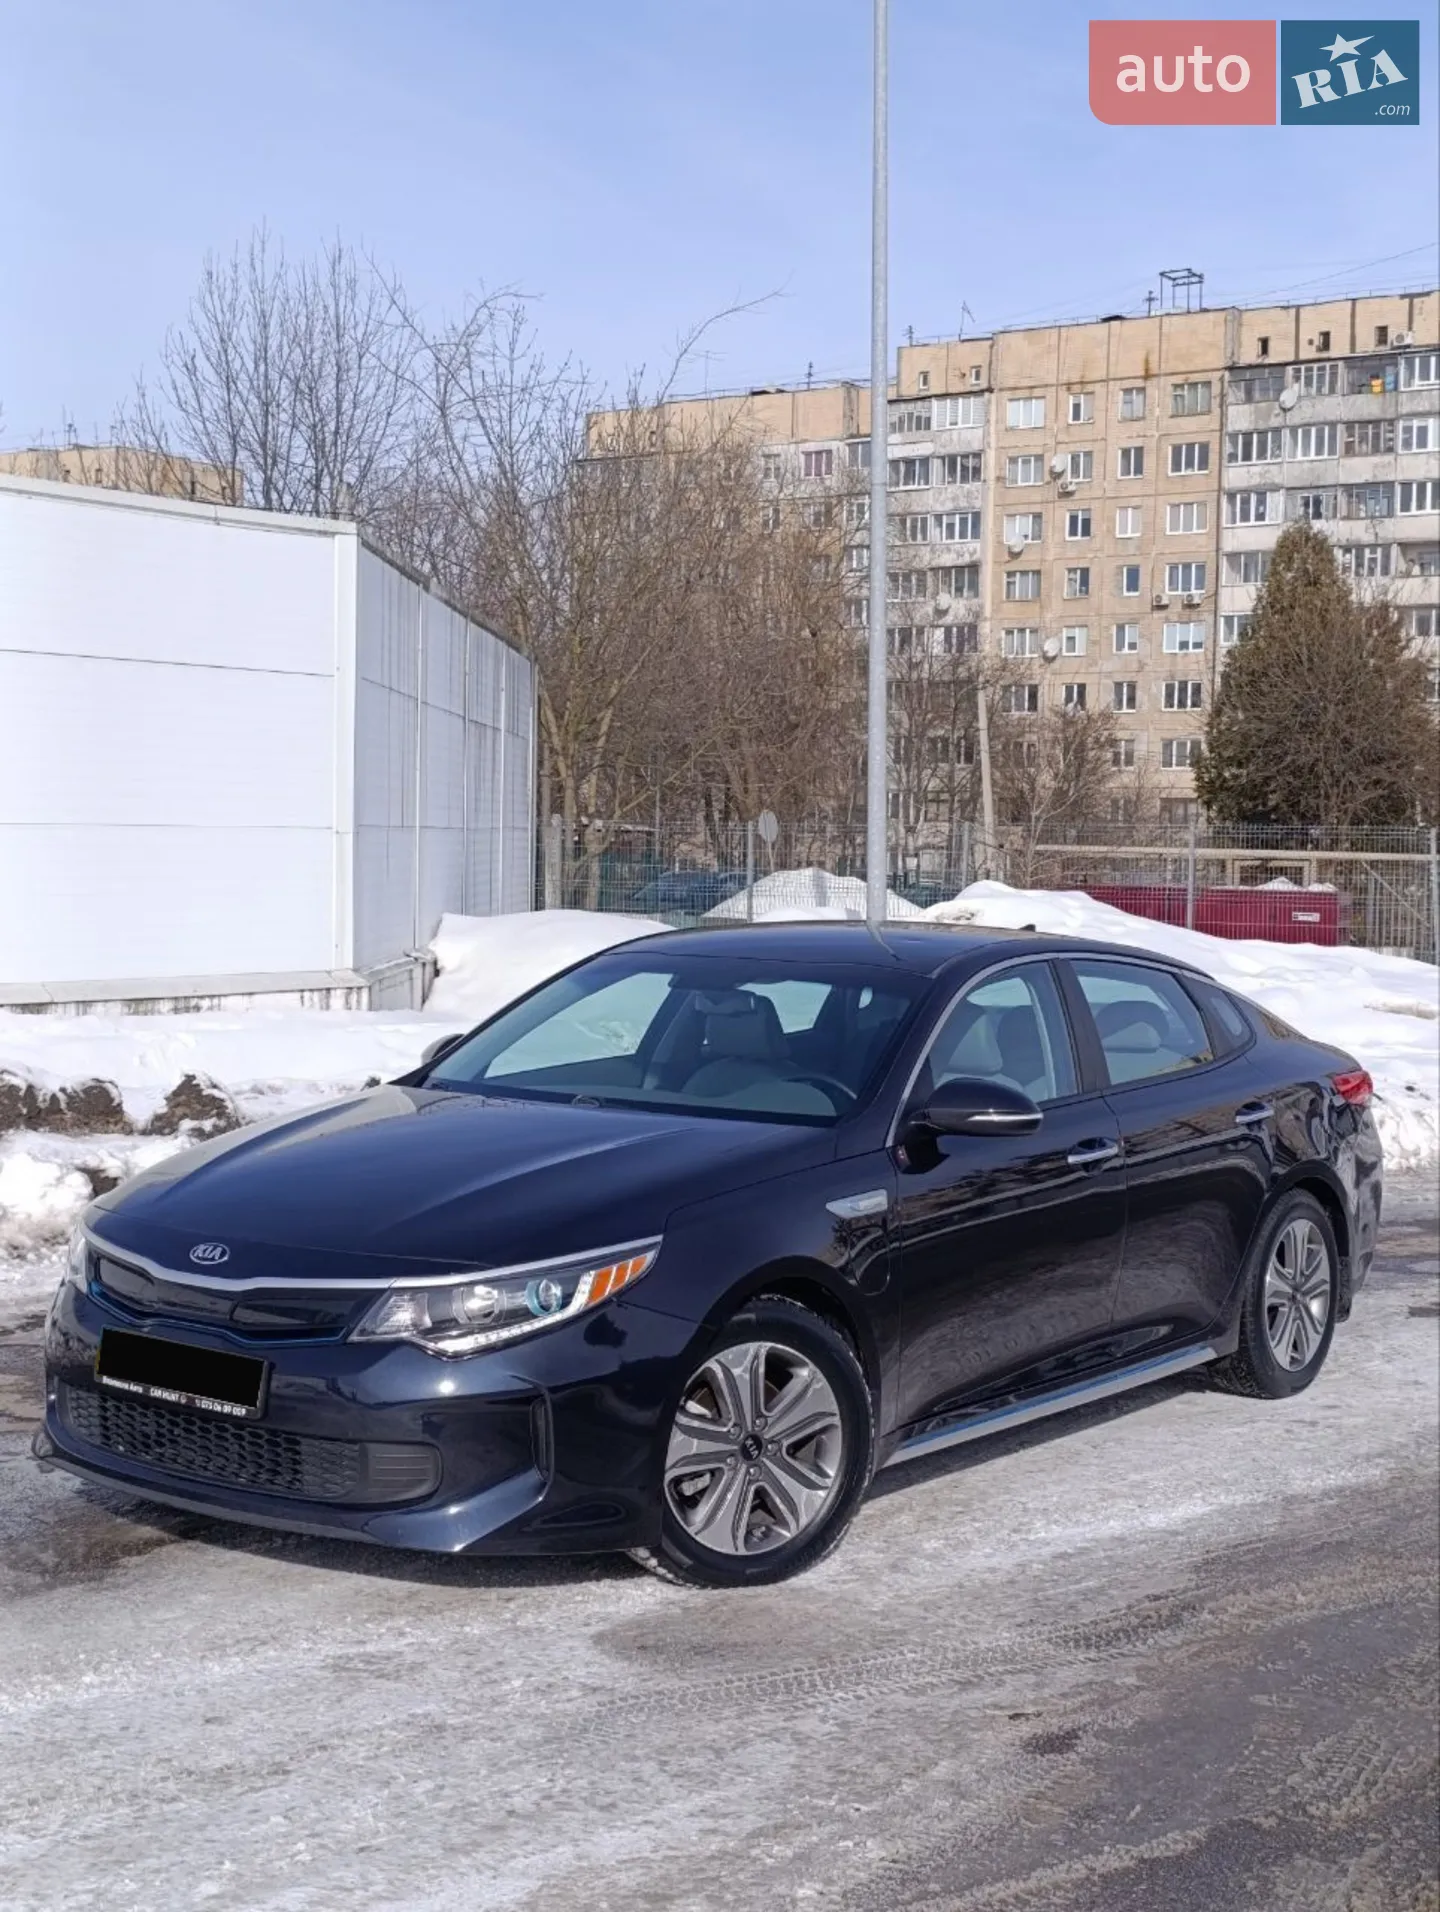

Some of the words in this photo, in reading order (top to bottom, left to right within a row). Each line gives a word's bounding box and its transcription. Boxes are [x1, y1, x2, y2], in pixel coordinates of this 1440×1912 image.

[193, 1243, 223, 1260] KIA
[150, 1387, 162, 1398] CAR
[745, 1437, 759, 1459] KIA
